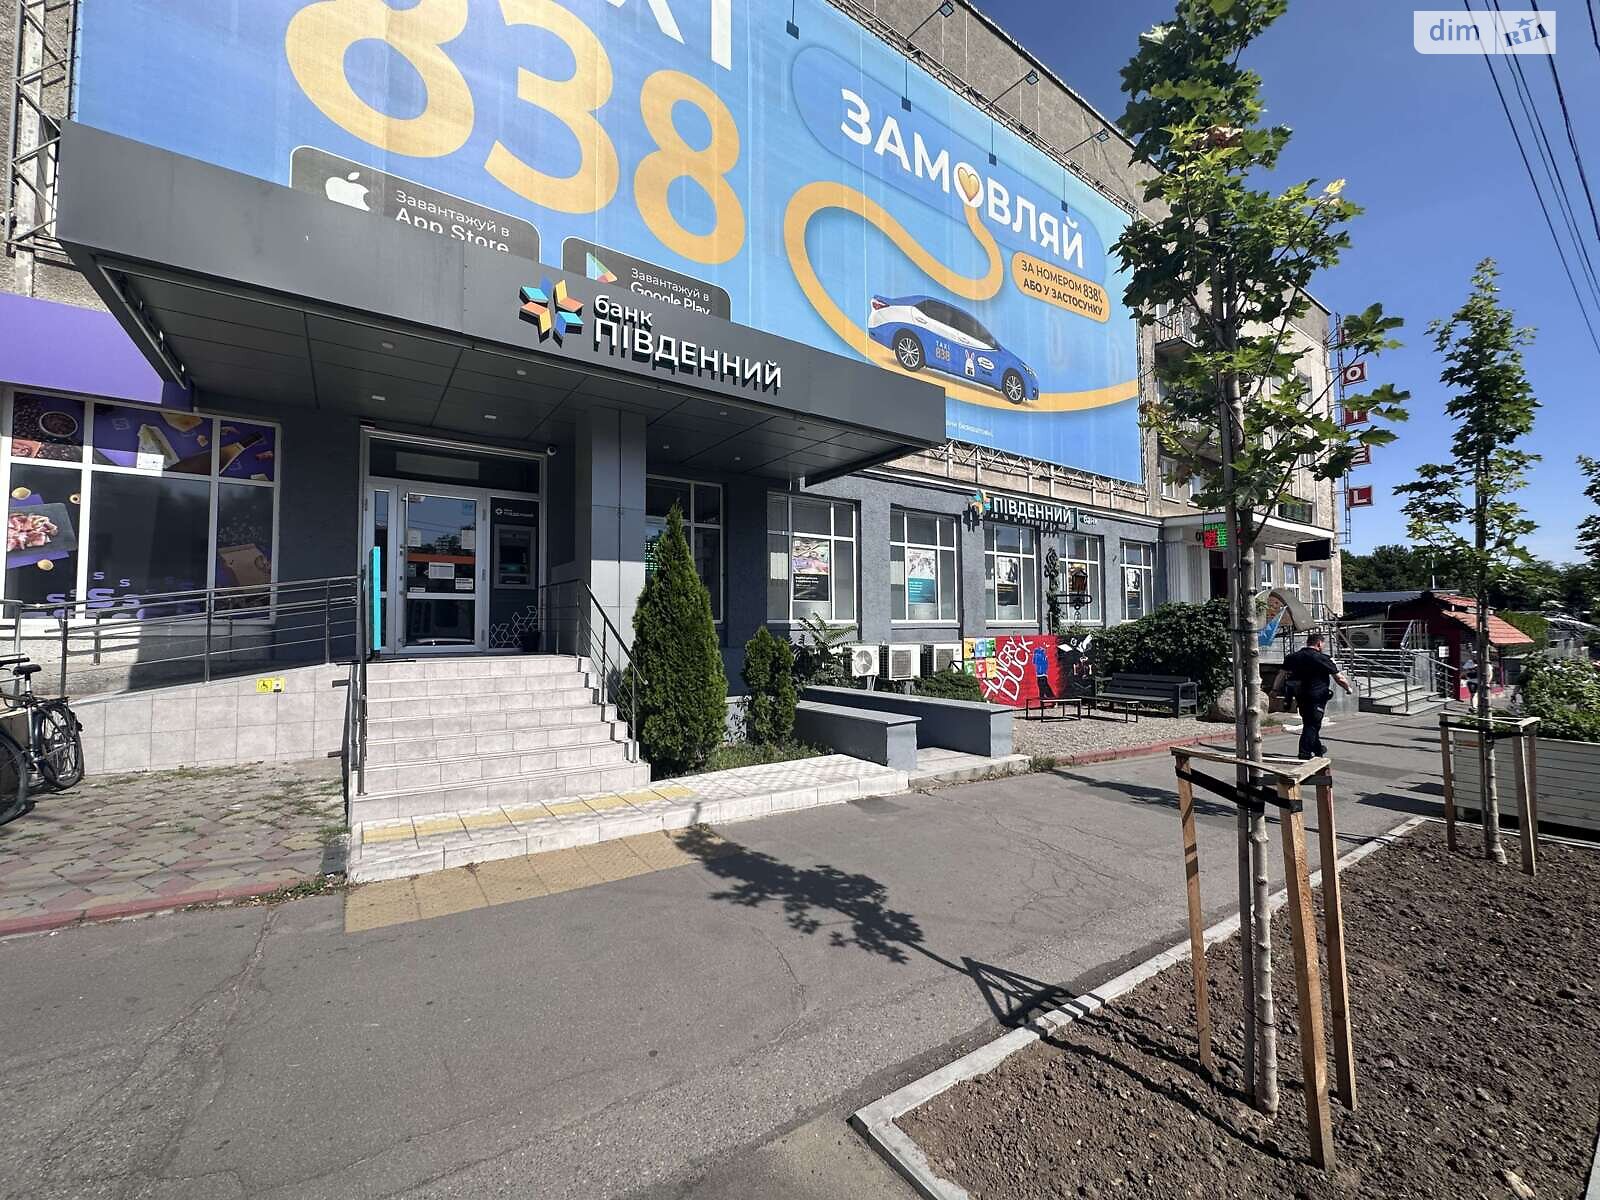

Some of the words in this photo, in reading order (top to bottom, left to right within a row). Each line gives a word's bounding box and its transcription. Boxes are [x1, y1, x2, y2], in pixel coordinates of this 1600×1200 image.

[285, 0, 745, 264] 838
[841, 88, 1083, 268] ЗАМОВЛЯЙ
[396, 190, 496, 233] Завантажуй
[501, 227, 510, 237] в
[631, 267, 700, 298] Завантажуй
[1022, 260, 1034, 274] ЗА
[1036, 265, 1081, 293] НОМЕРОМ
[1023, 278, 1042, 292] АБО
[1044, 284, 1050, 296] У
[1052, 288, 1102, 315] ЗАСТОСУНКУ
[594, 294, 653, 327] банк
[595, 318, 782, 389] ПІВДЕННИЙ
[993, 497, 1071, 524] ПІВДЕННИЙ
[983, 636, 1018, 698] HUNGRY
[1001, 636, 1033, 701] DUCK
